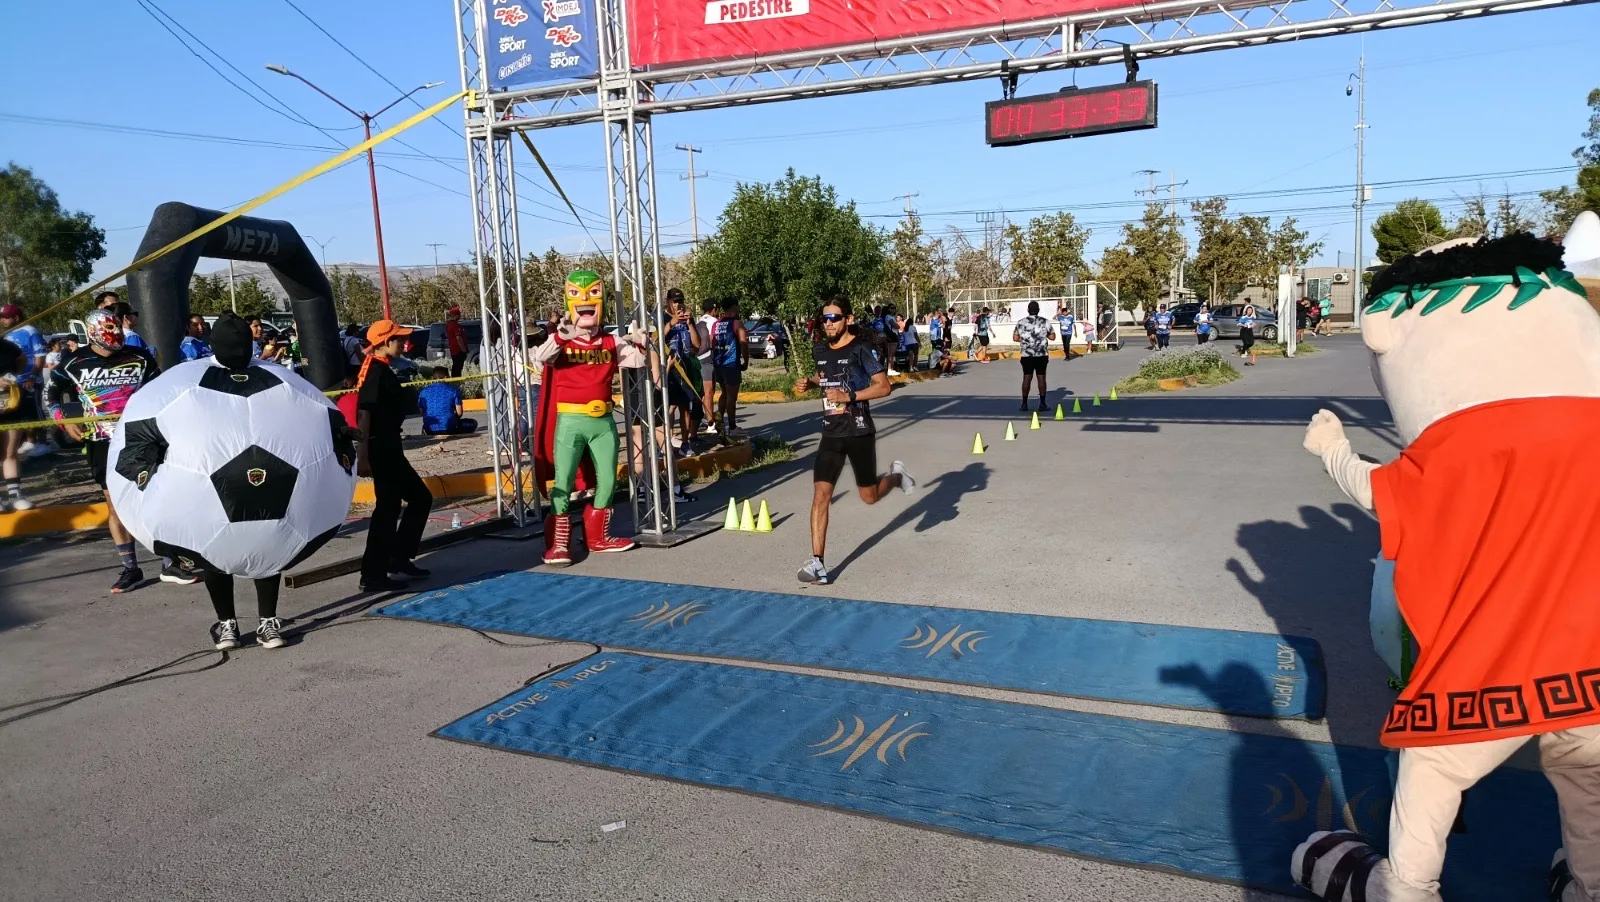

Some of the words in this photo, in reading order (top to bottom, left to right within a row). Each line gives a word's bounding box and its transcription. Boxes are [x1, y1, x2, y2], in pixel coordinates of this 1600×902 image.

[720, 0, 793, 20] PEDESTRE
[499, 40, 526, 53] SPORT
[550, 56, 580, 68] SPORT
[224, 225, 279, 255] META
[566, 347, 612, 365] LUCHO
[80, 367, 141, 384] MASCA
[83, 377, 138, 389] RUNNERS
[486, 692, 549, 726] ACTIVE
